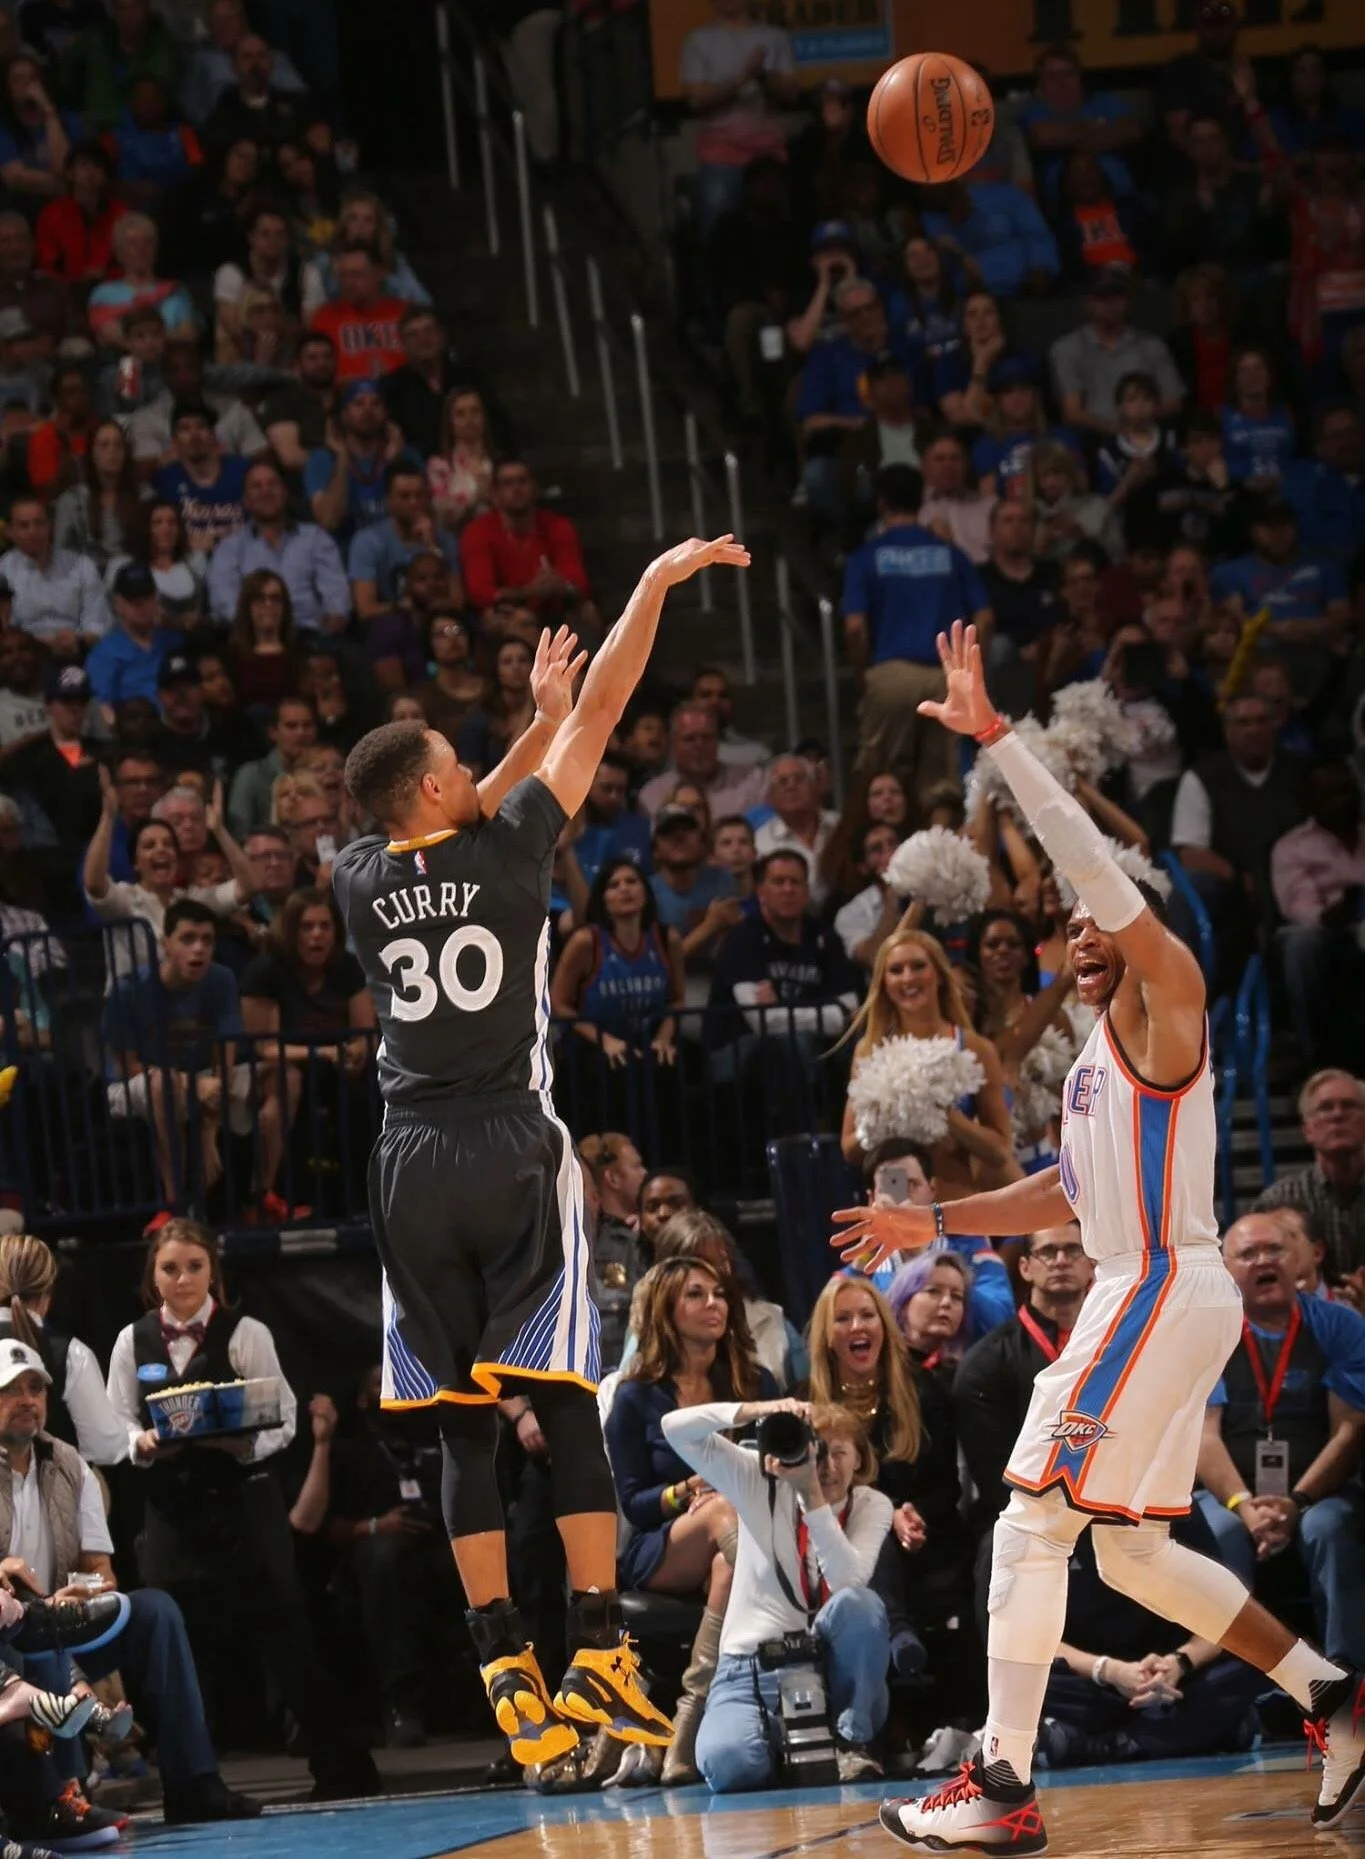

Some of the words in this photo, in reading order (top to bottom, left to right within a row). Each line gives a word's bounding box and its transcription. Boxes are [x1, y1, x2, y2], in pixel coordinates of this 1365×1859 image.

[930, 77, 957, 165] SPALDING
[372, 881, 481, 930] CURRY
[378, 924, 504, 1022] 30
[157, 1395, 201, 1412] THUNDER
[1052, 1421, 1097, 1437] OKC
